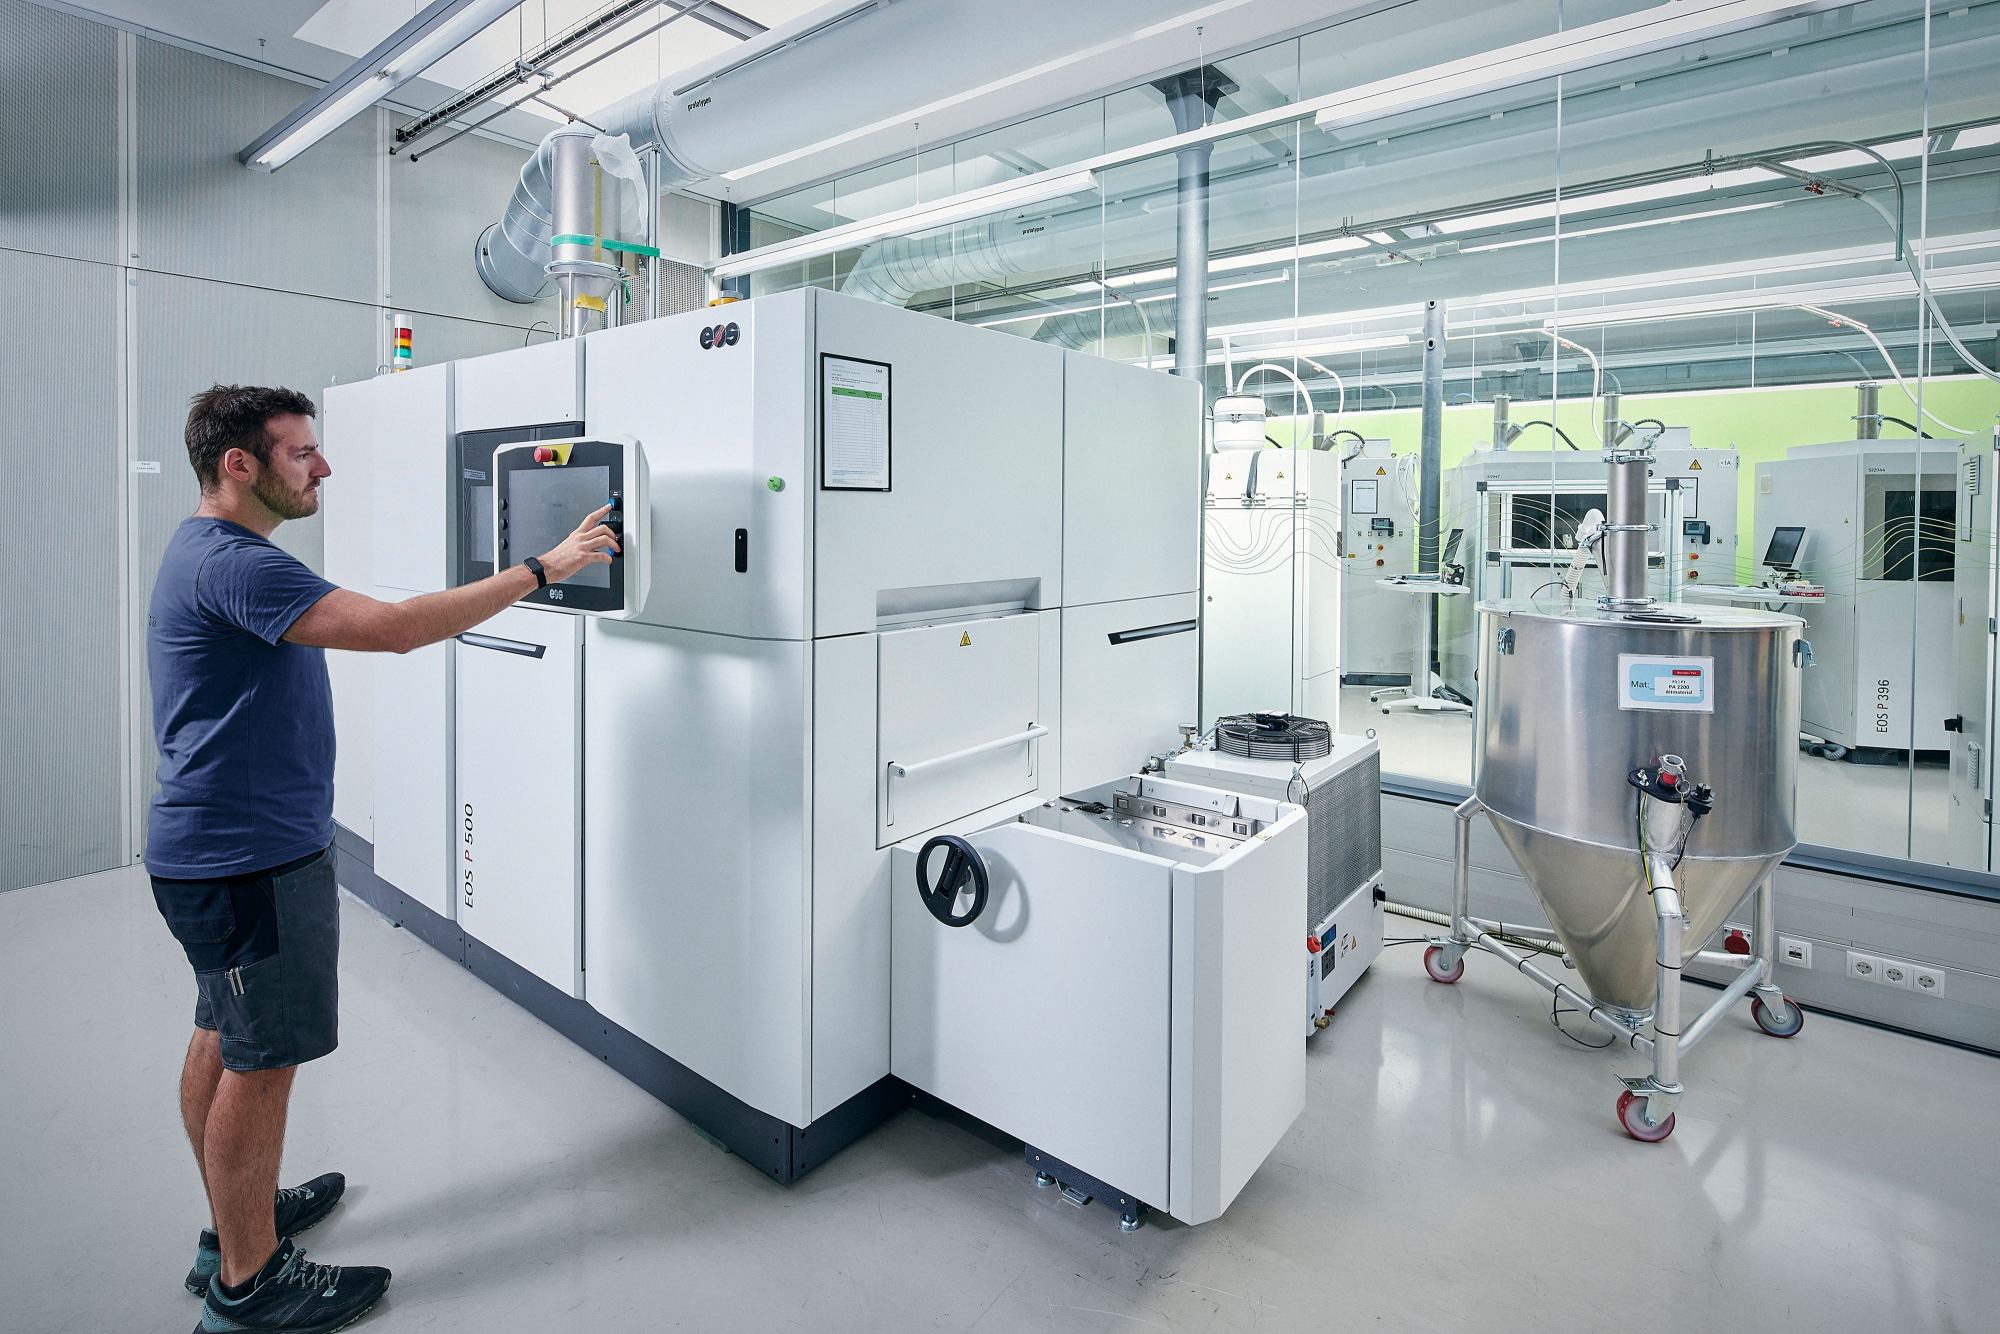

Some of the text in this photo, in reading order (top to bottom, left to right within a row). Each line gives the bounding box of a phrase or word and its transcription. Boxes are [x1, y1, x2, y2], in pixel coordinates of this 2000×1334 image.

[1630, 680, 1650, 688] Mat:
[1877, 679, 1890, 701] 396
[1876, 713, 1889, 733] EOS
[464, 803, 474, 909] EOS P 500
